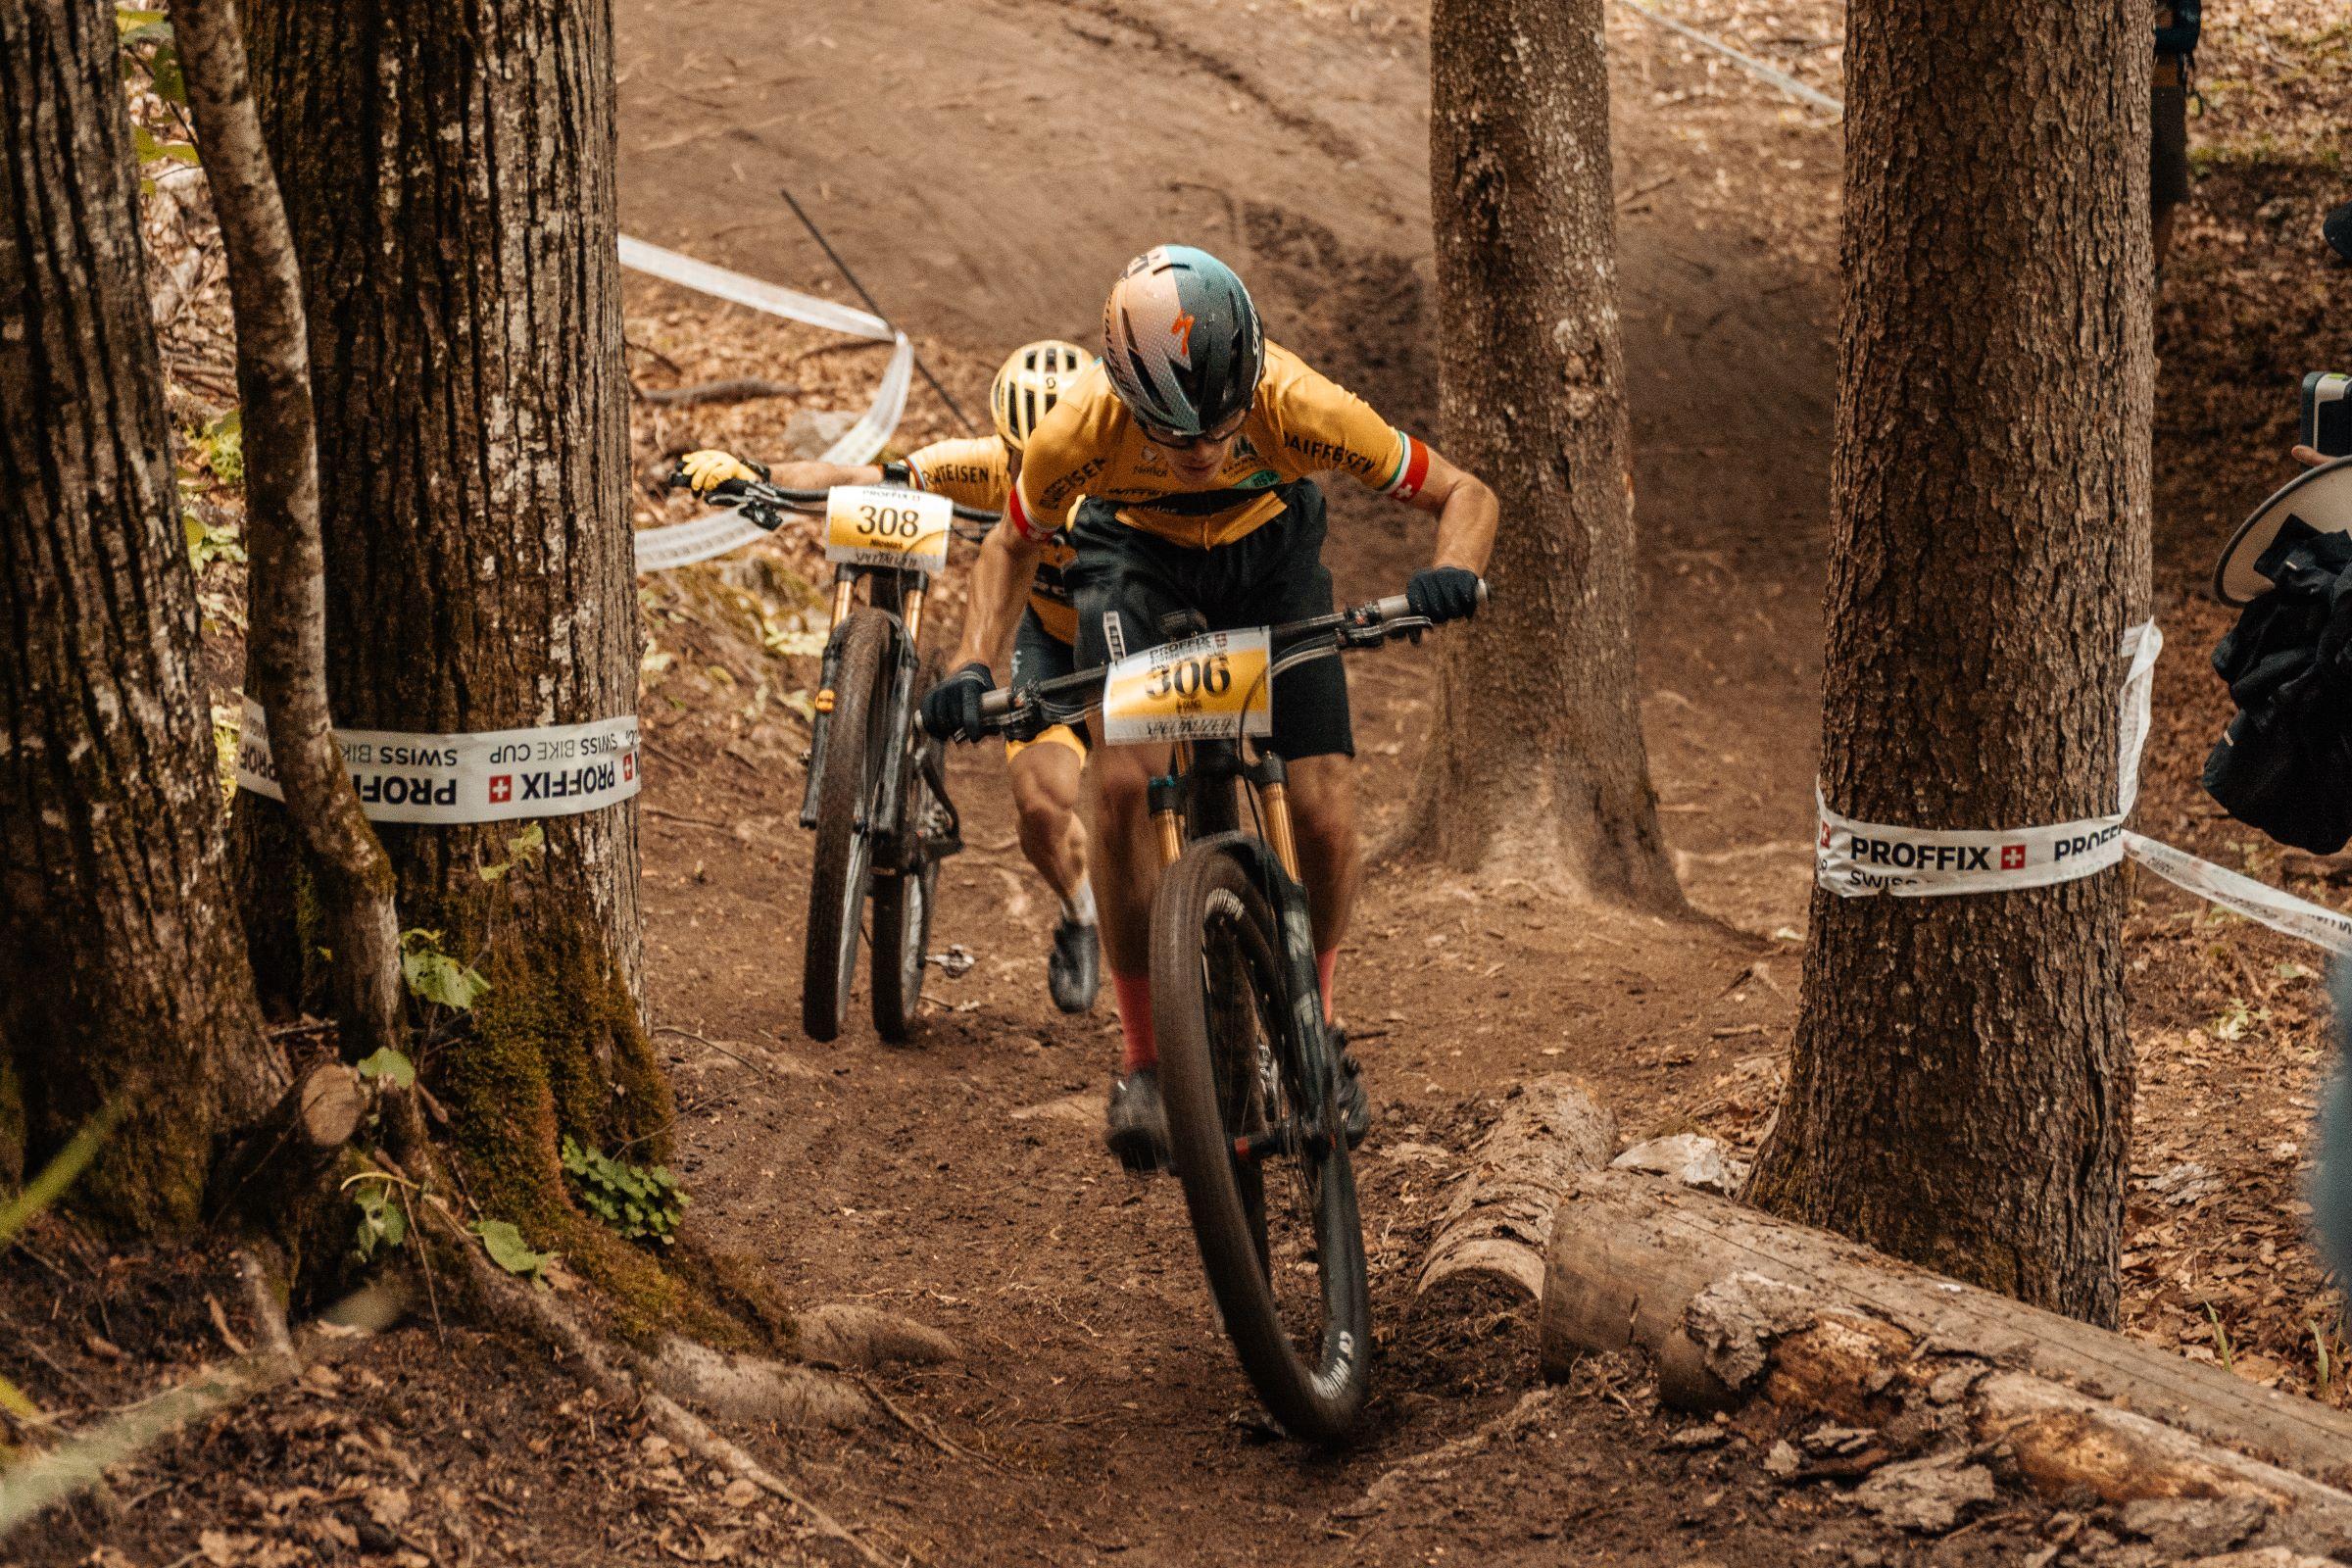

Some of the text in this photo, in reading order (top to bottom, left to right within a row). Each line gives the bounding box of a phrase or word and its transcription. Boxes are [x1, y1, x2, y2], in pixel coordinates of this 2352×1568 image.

[857, 505, 919, 538] 308
[1145, 658, 1232, 699] 306
[379, 746, 458, 766] SWISS
[489, 745, 531, 764] CUP
[536, 739, 575, 760] BIKE
[580, 733, 618, 756] SWISS
[521, 760, 615, 801] PROFFIX
[1850, 836, 1990, 871] PROFFIX
